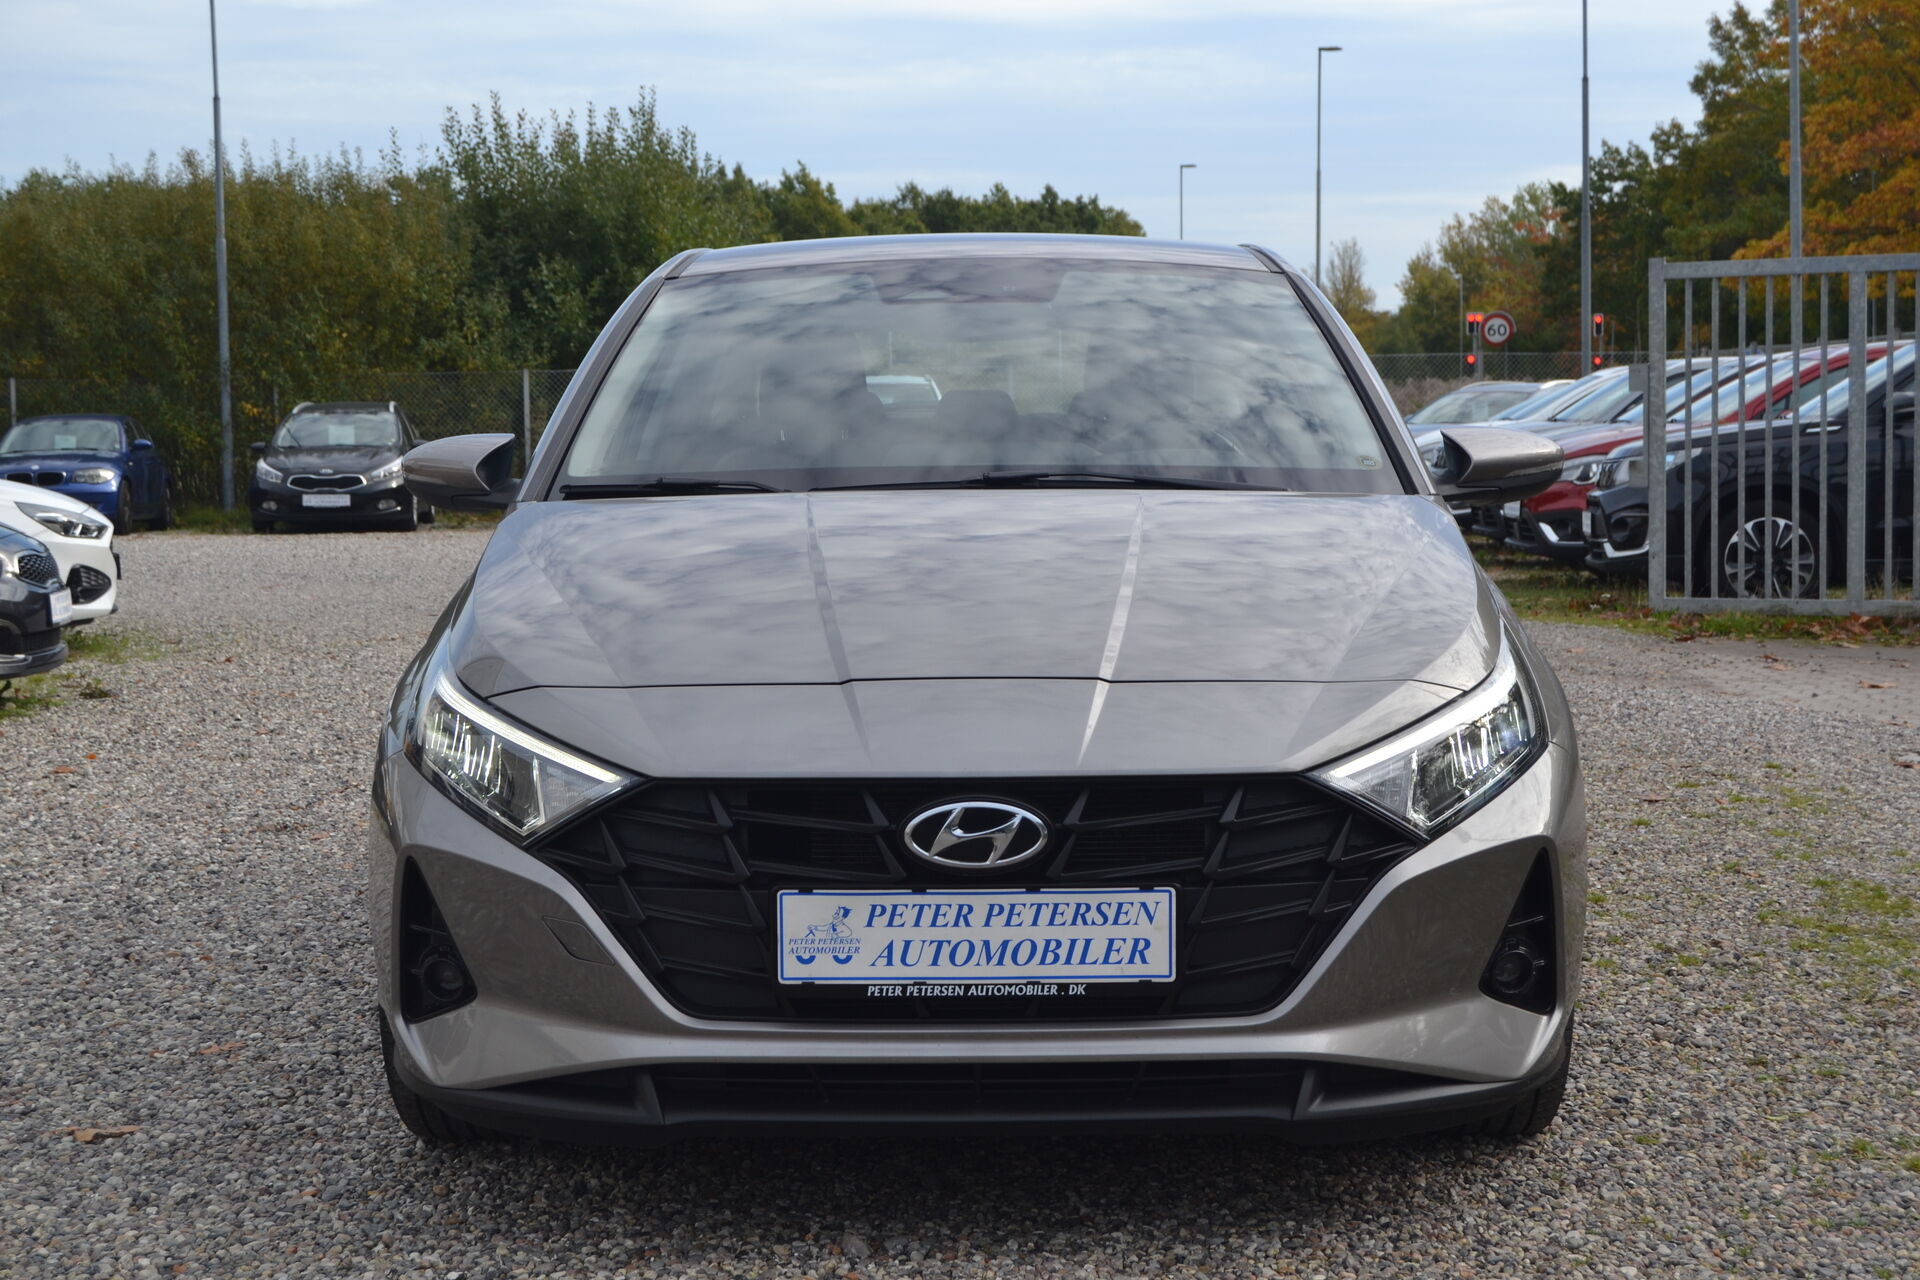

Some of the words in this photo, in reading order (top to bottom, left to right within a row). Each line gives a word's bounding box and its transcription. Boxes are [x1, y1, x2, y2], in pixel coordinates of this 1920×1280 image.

[1487, 323, 1507, 337] 60
[864, 903, 974, 928] PETER
[981, 901, 1161, 927] PETERSEN
[788, 937, 816, 945] PETER
[817, 937, 862, 945] PETERSEN
[788, 946, 861, 955] AUTOMOBILER
[869, 938, 1151, 967] AUTOMOBILER
[867, 985, 903, 997] PETER
[906, 985, 964, 997] PETERSEN
[967, 984, 1058, 996] AUTOMOBILER
[1068, 984, 1086, 995] DK
